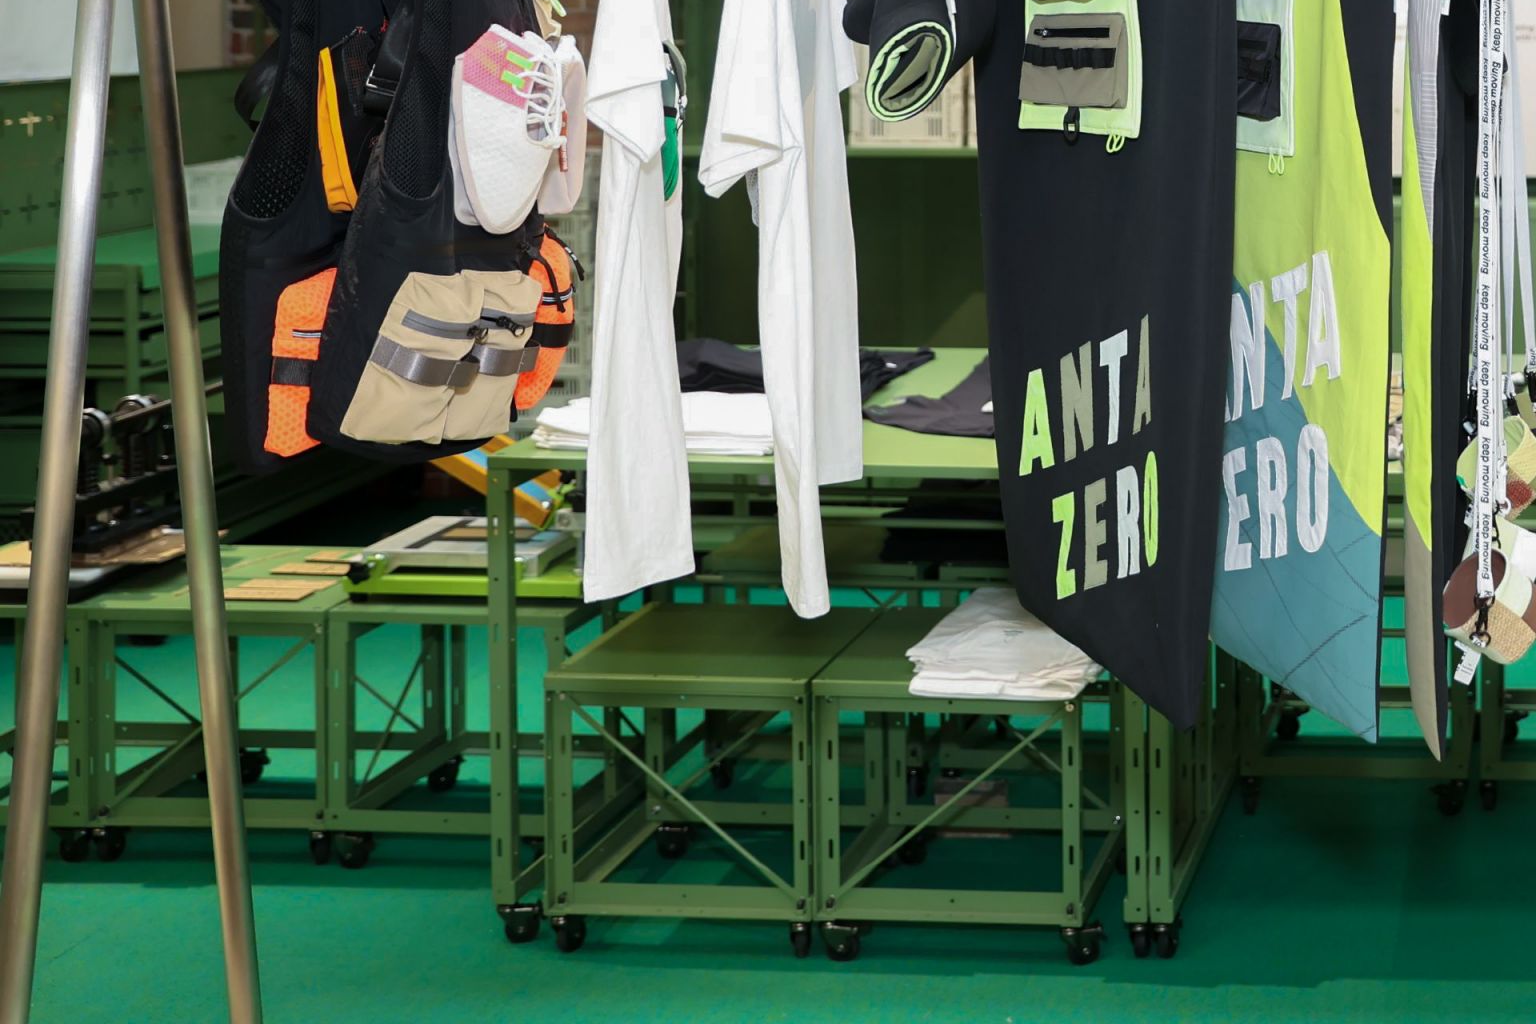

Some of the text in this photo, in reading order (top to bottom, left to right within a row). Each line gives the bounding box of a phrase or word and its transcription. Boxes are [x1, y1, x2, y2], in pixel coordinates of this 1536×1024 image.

[1492, 27, 1502, 52] keep
[1491, 61, 1500, 98] moving
[1482, 161, 1490, 199] moving
[1481, 209, 1490, 274] keep moving
[1224, 250, 1341, 423] NTA
[1480, 284, 1490, 351] keep moving
[1018, 314, 1152, 476] ANTA
[1480, 360, 1490, 427] keep moving
[1222, 423, 1330, 572] ERO
[1481, 437, 1491, 504] keep moving
[1052, 451, 1159, 600] ZERO
[1481, 514, 1491, 539] keep
[1481, 540, 1490, 580] moving
